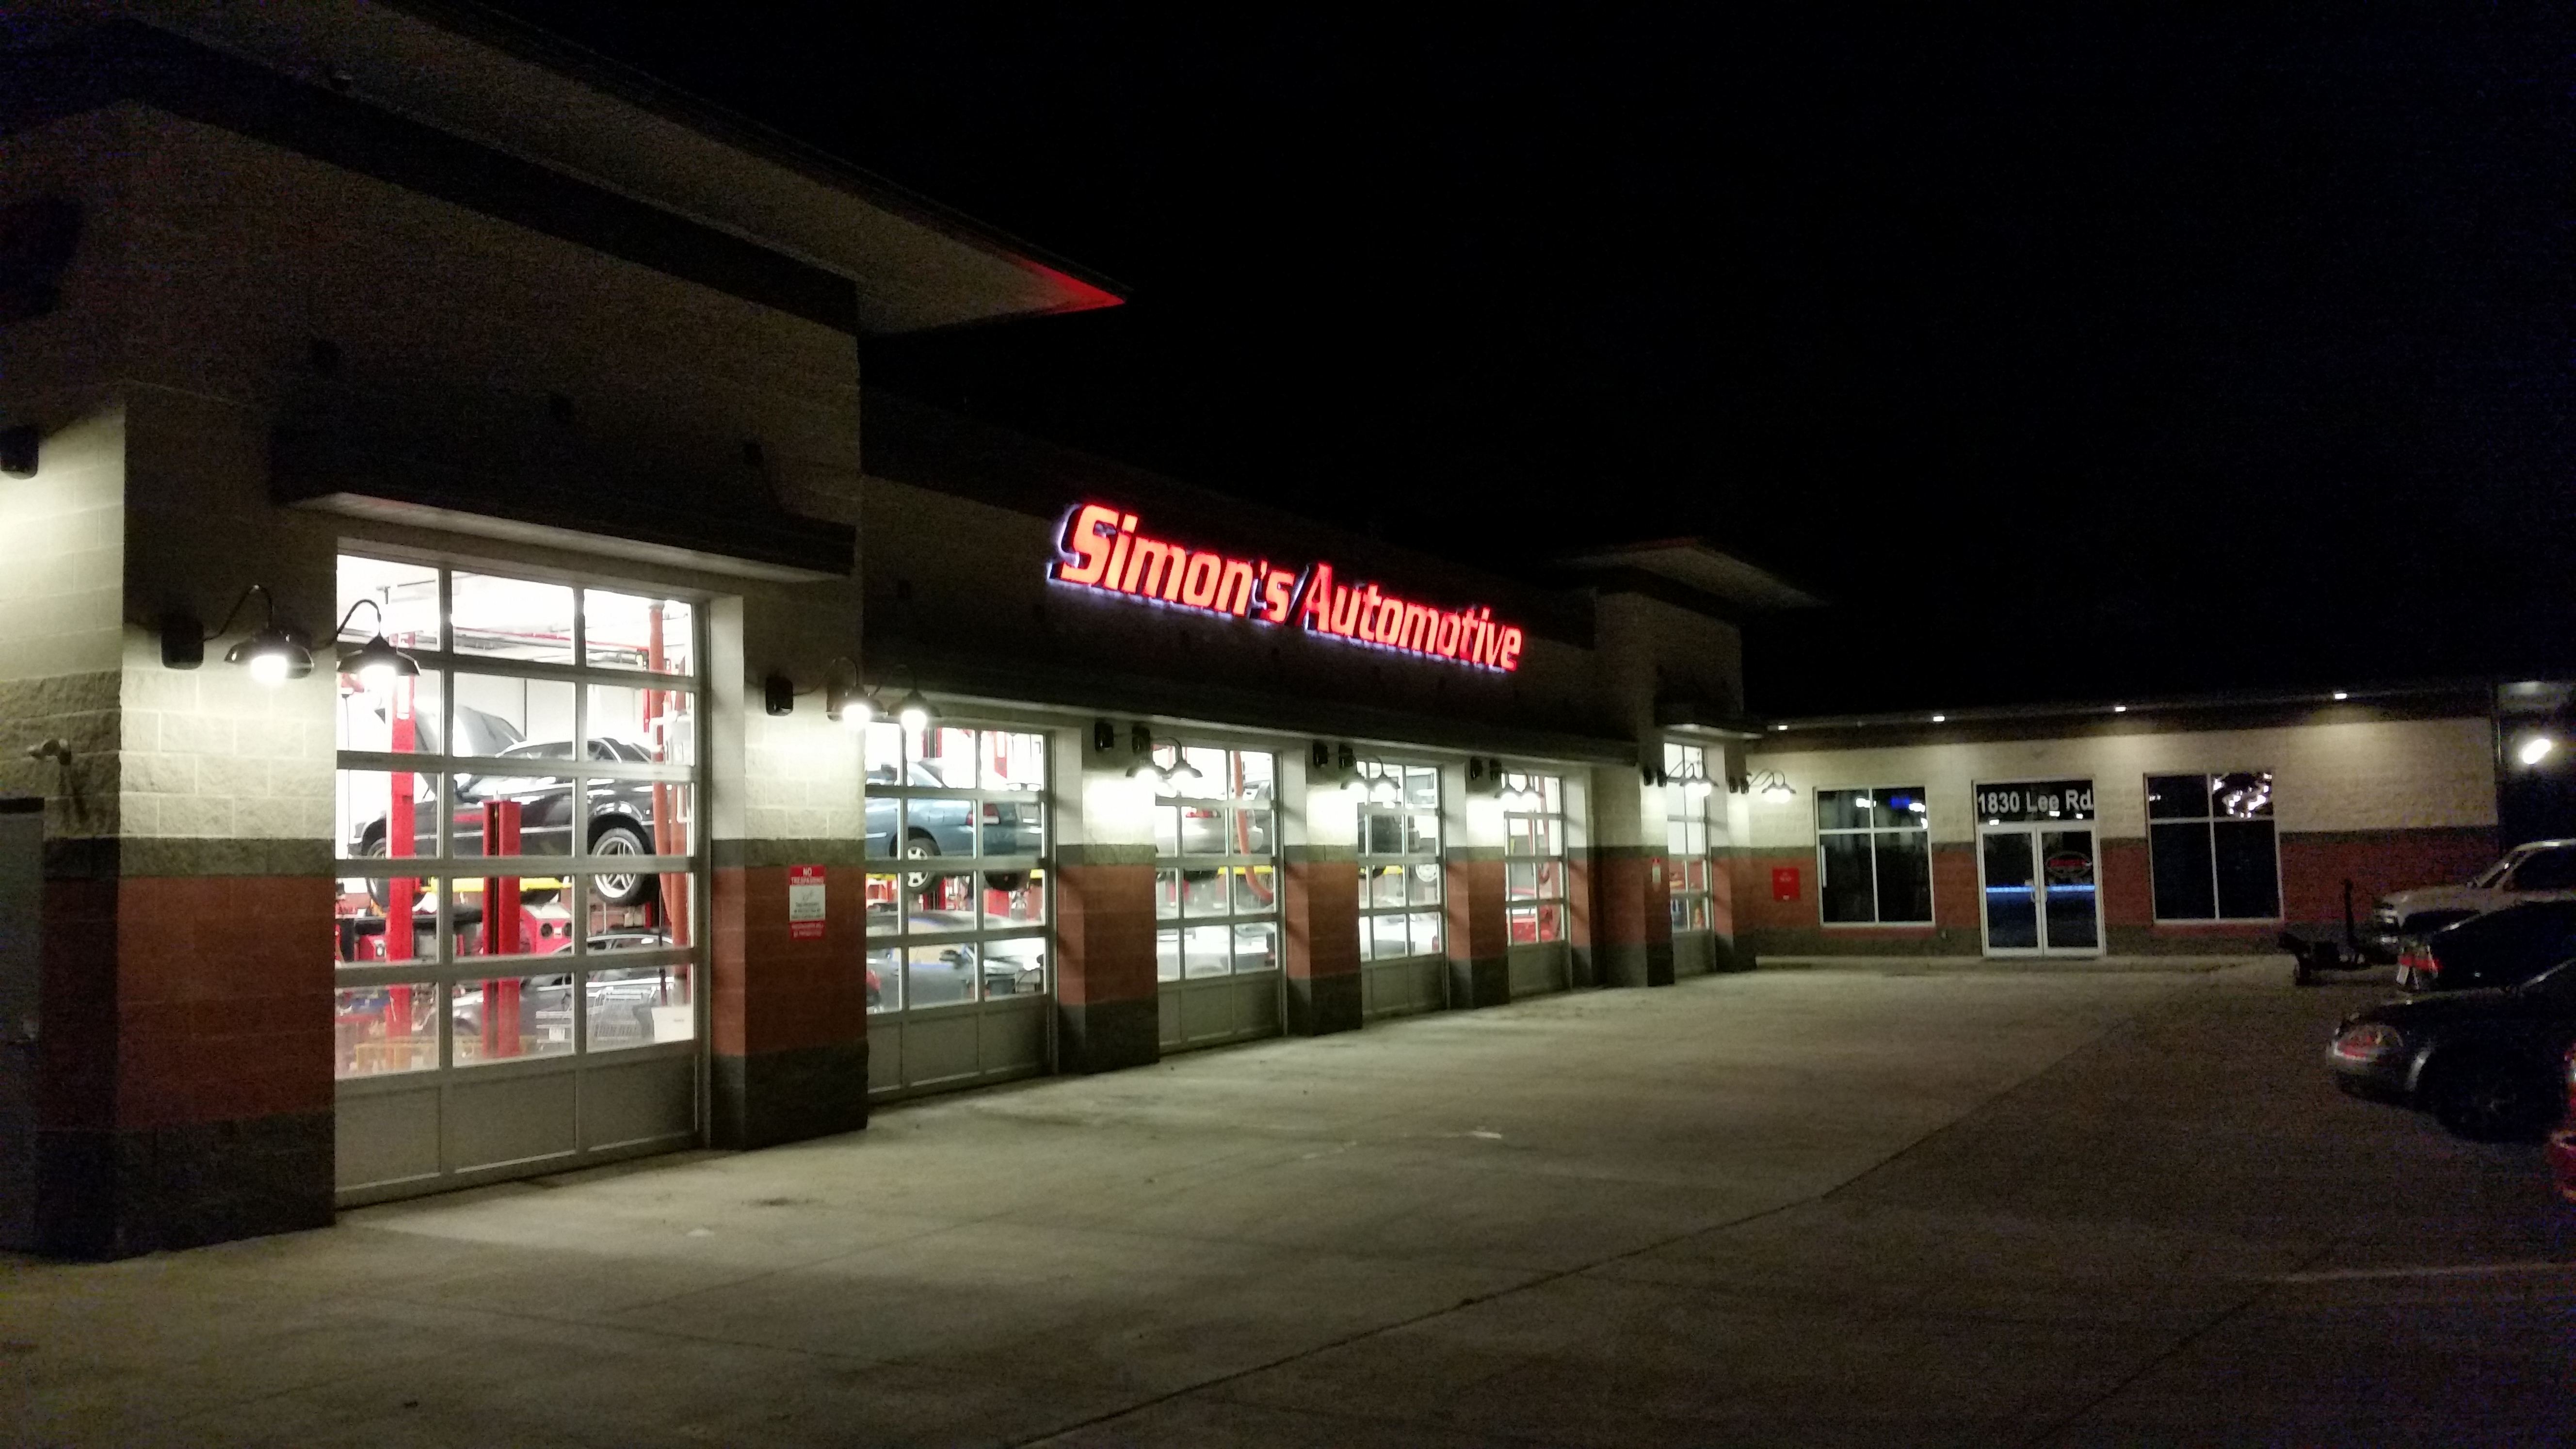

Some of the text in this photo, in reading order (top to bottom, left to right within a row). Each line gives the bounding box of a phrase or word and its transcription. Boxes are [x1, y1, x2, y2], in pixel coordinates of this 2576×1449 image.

[1058, 503, 1522, 672] Simon's Automotive
[1978, 791, 2020, 814] 1830
[2026, 790, 2060, 813] Lee
